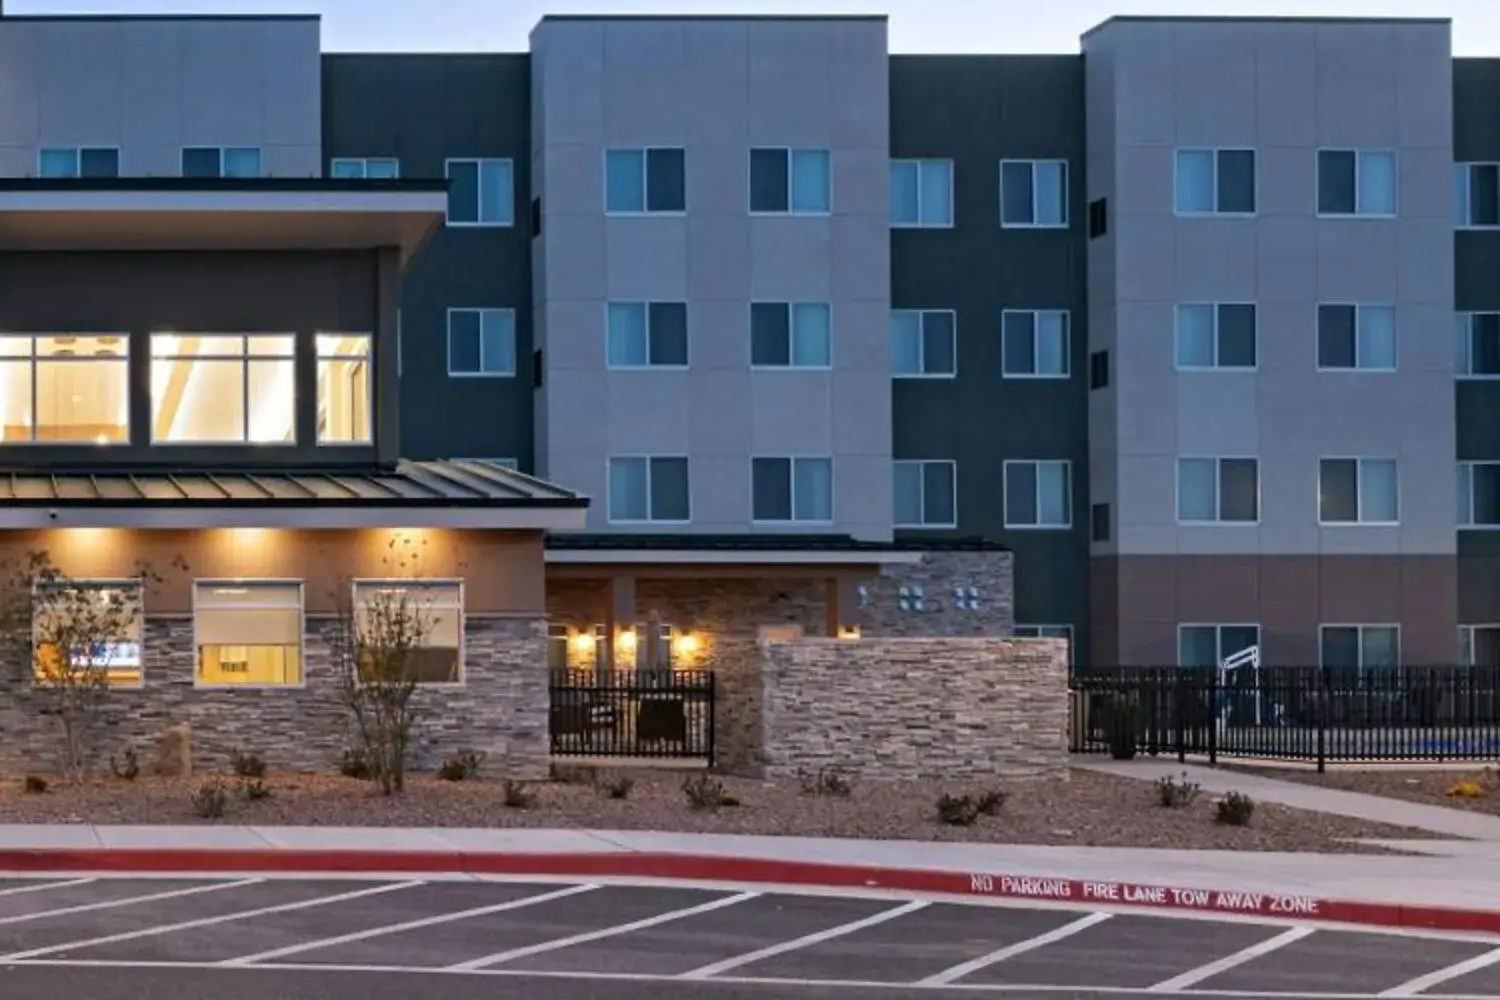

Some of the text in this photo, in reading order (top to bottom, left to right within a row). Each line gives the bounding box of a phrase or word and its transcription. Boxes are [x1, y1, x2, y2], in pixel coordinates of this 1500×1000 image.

[970, 873, 1319, 913] NO PARKING FIRE LANE TOW AWAY ZONE
